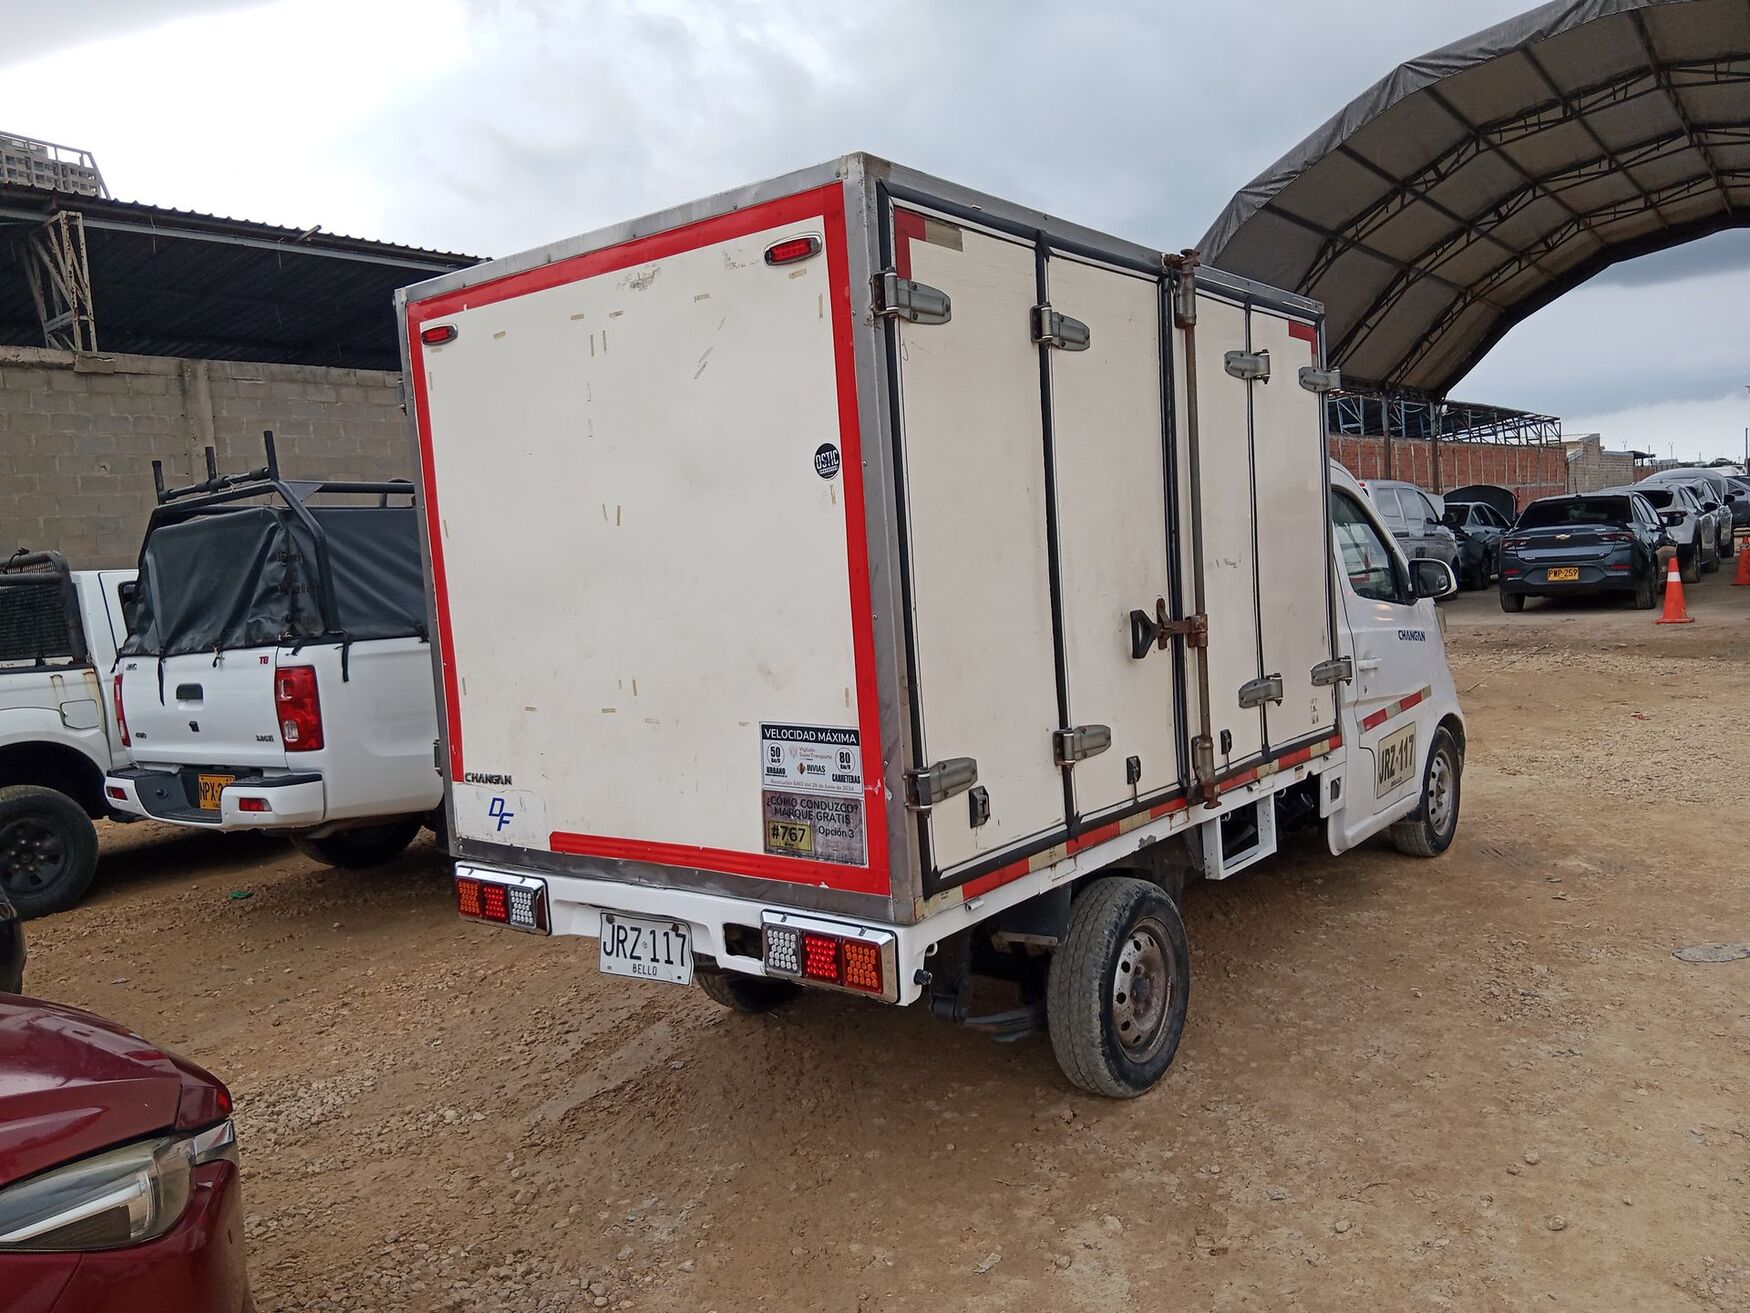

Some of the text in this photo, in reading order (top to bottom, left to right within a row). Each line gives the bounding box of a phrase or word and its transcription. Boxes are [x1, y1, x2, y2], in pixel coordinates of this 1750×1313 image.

[816, 450, 838, 470] OSTIC
[1398, 630, 1426, 641] CHANGAN
[764, 728, 857, 744] VELOCIDAD MÁXIMA
[770, 746, 780, 758] 50
[839, 752, 850, 764] 80
[766, 766, 786, 774] URBANO
[464, 772, 512, 786] CHANGAN
[832, 773, 860, 784] CARRETERAS
[800, 799, 858, 814] CONDUZCO?
[774, 807, 850, 824] MARQUE GRATIS
[772, 824, 854, 842] #767 Opción 3
[632, 963, 658, 976] BELLO
